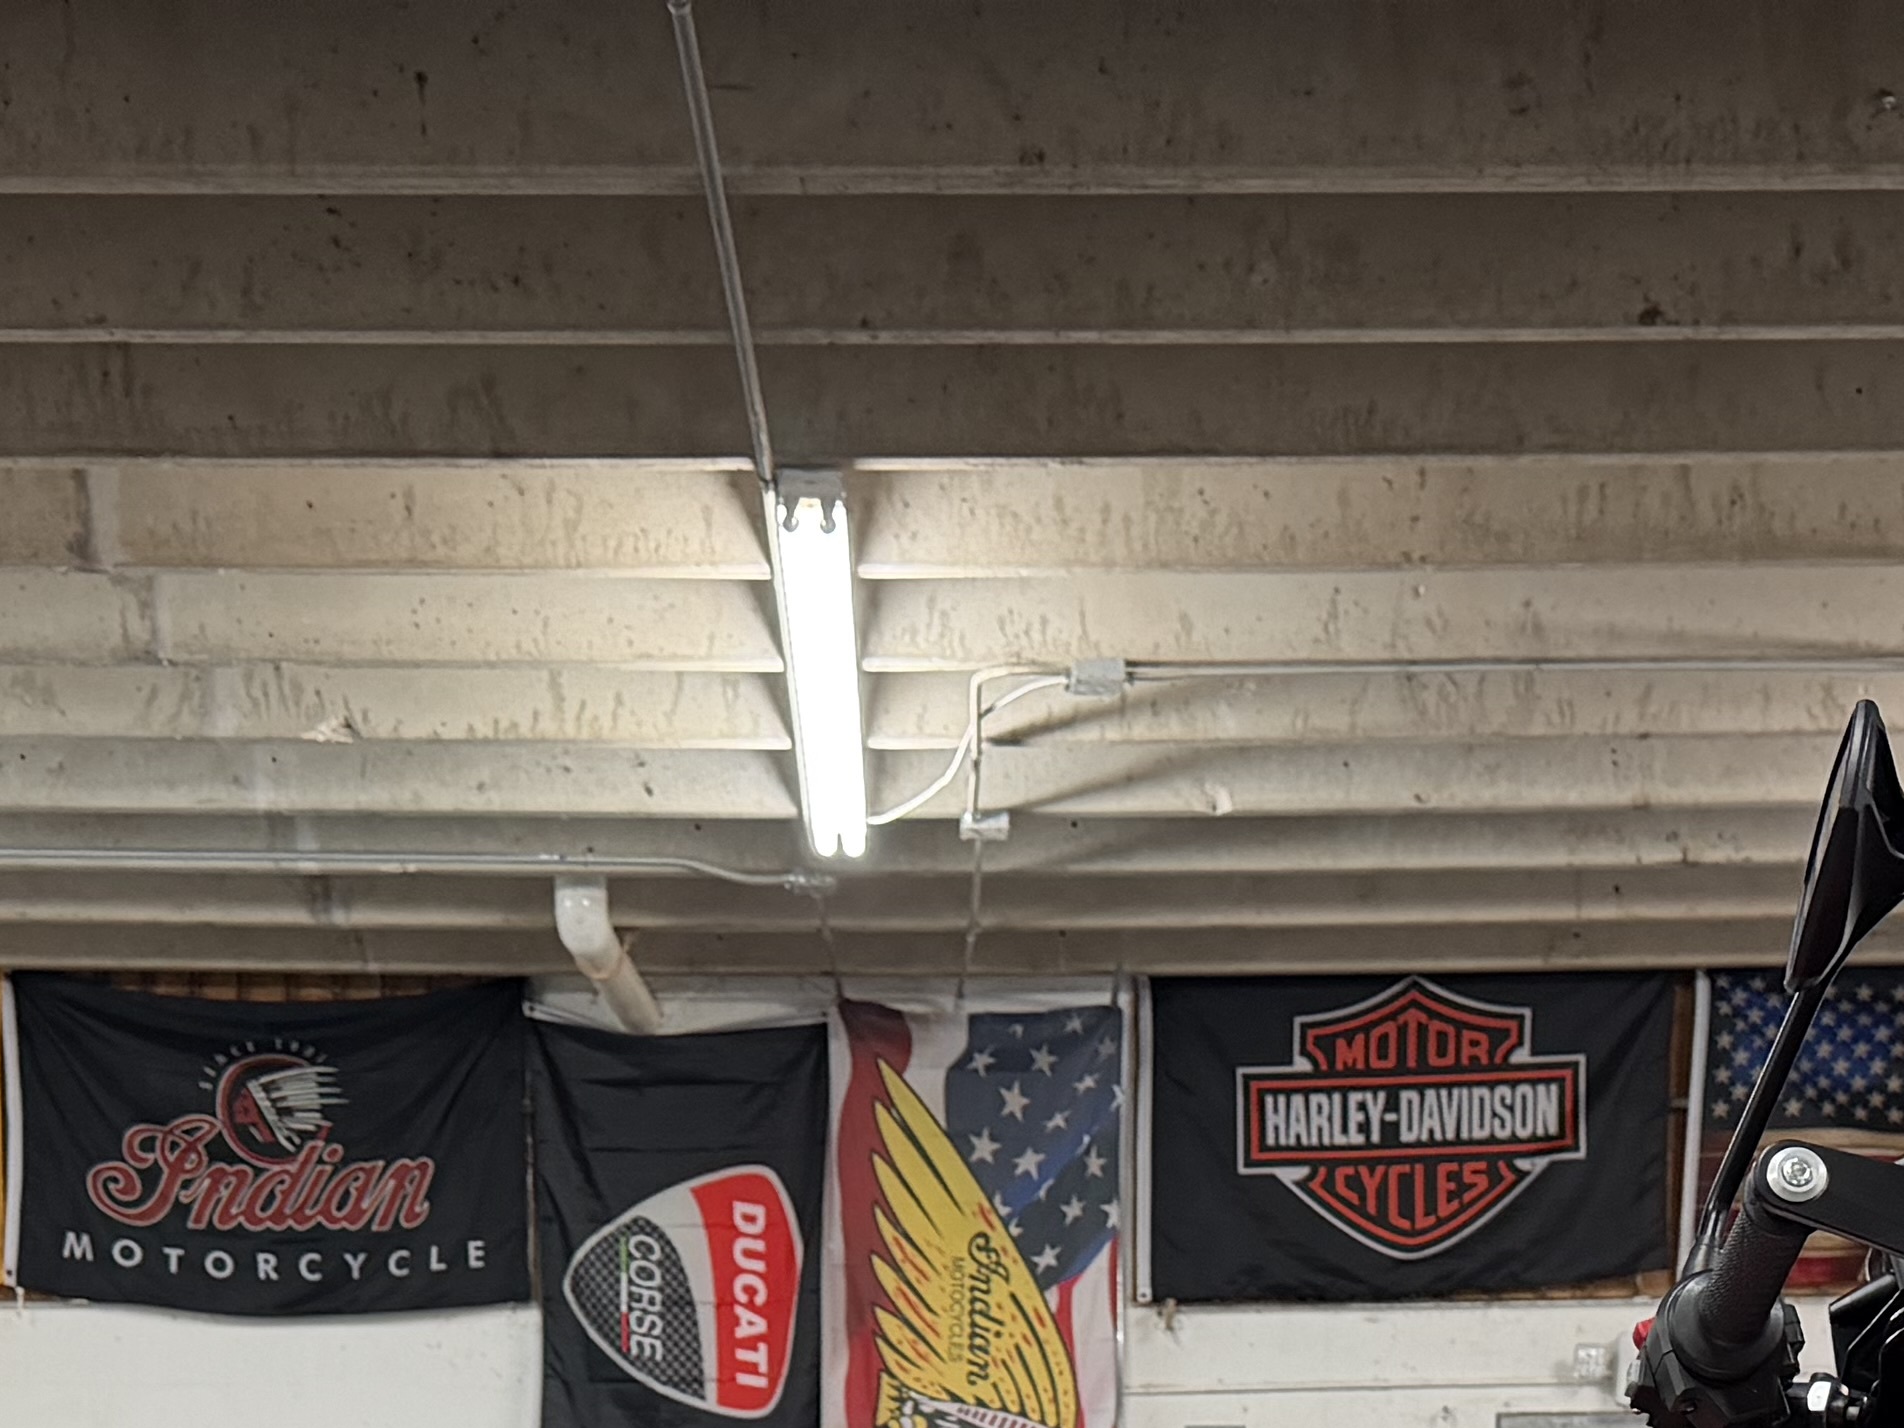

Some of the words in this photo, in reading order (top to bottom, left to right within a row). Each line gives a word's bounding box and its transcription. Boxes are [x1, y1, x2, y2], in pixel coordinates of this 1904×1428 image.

[1335, 1007, 1491, 1072] MOTOR
[1264, 1082, 1560, 1147] HARLEY-DAVIDSON
[86, 1114, 436, 1232] Indian
[1334, 1160, 1490, 1231] CYCLES
[61, 1231, 487, 1282] MOTORCYCLE
[628, 1234, 664, 1363] CORSE
[732, 1200, 769, 1390] DUCATI
[966, 1231, 1010, 1387] Indian
